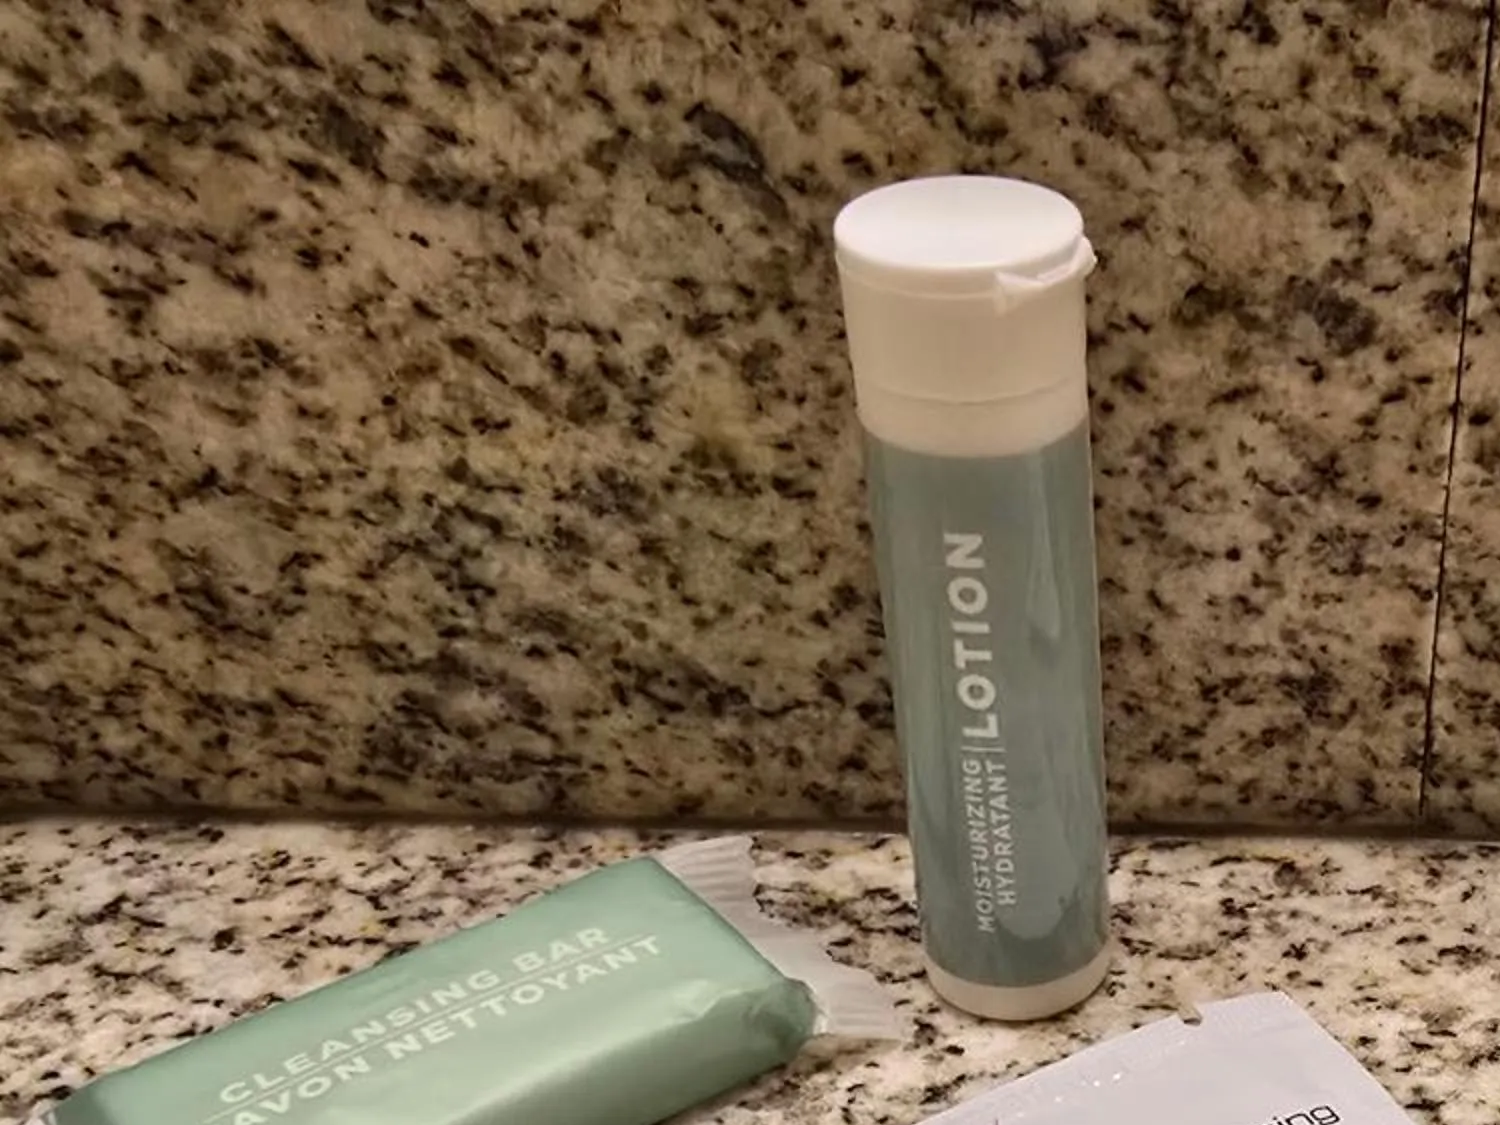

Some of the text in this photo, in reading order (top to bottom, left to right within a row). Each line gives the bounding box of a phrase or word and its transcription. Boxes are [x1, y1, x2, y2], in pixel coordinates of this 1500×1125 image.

[943, 532, 1000, 741] LOTION
[963, 758, 997, 935] MOISTURIZING
[988, 759, 1018, 906] HYDRATANT
[219, 926, 610, 1104] CLEANSING BAR
[384, 935, 662, 1061] NETTOYANT
